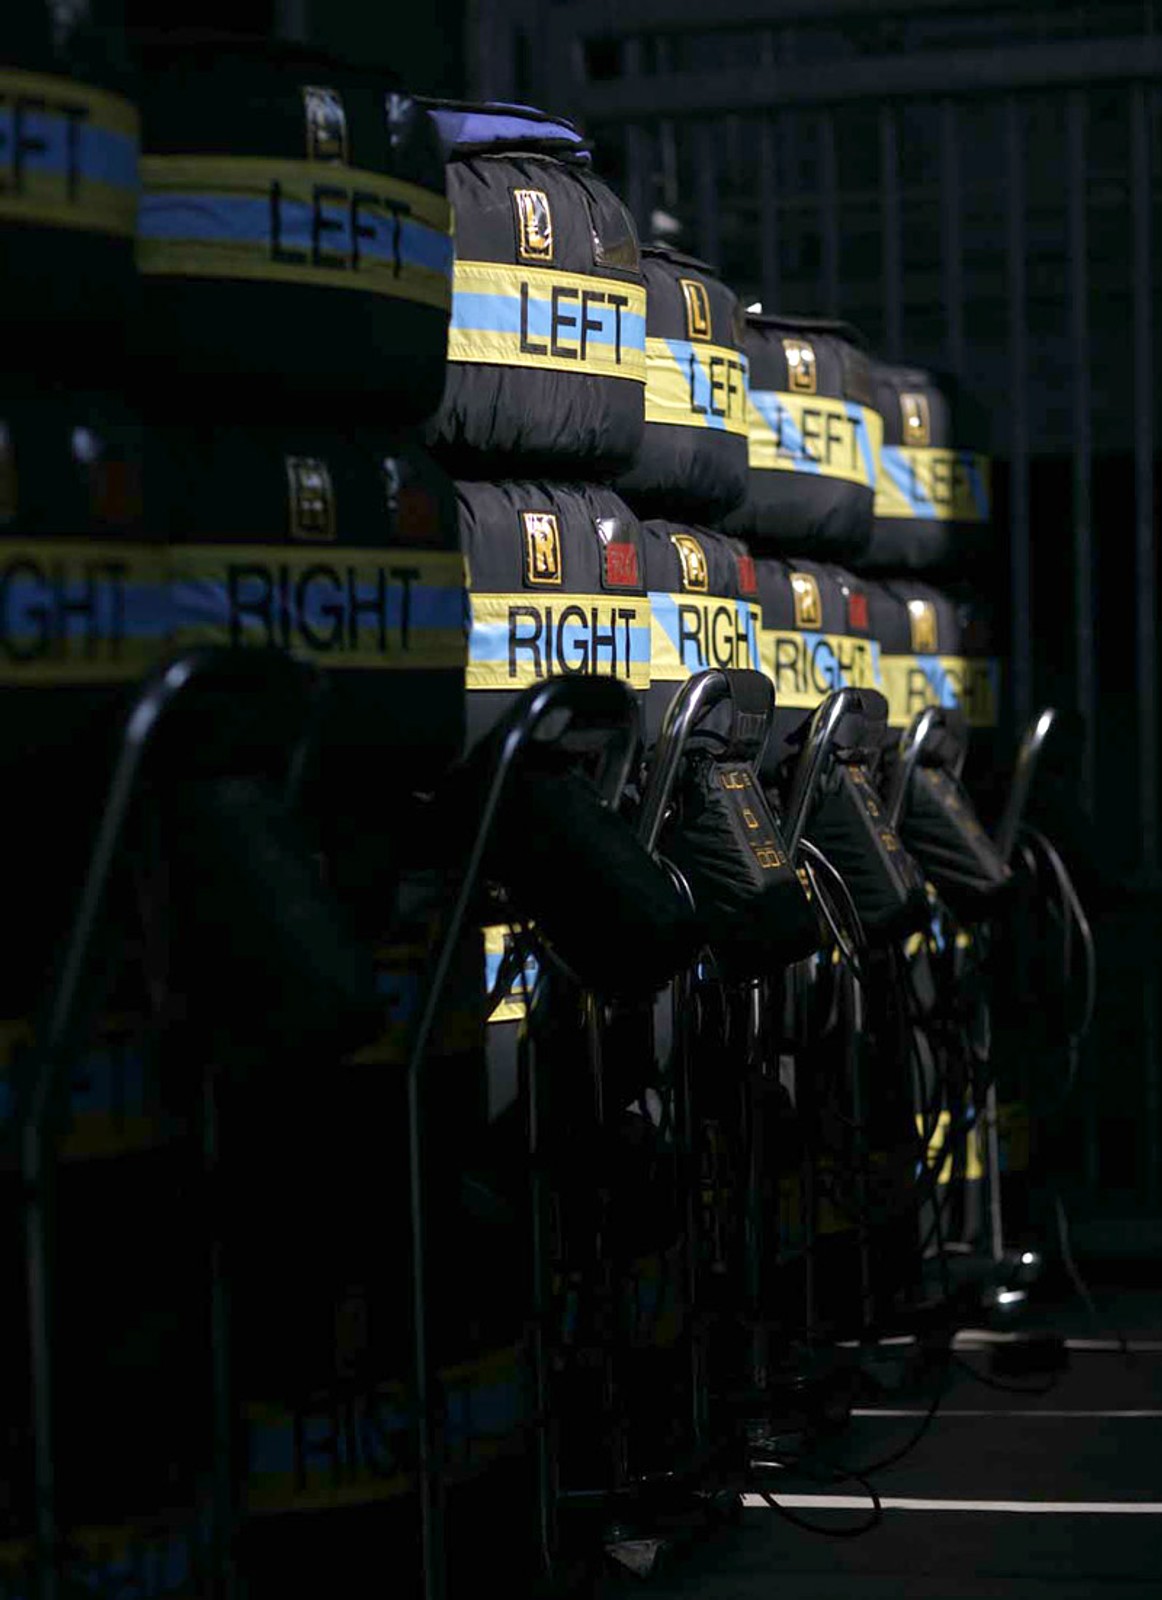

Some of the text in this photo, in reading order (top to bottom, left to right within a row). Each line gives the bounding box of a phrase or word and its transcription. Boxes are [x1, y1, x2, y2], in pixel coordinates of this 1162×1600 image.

[0, 88, 89, 204] FT
[268, 181, 411, 279] LEFT
[519, 281, 629, 365] LEFT
[686, 282, 708, 332] L
[689, 352, 748, 425] LEFT
[777, 402, 861, 472] LEFT
[530, 513, 558, 576] R
[226, 563, 421, 655] RIGHT
[507, 604, 637, 679] RIGHT
[677, 603, 759, 670] RIGHT
[775, 637, 867, 698] RIGHT
